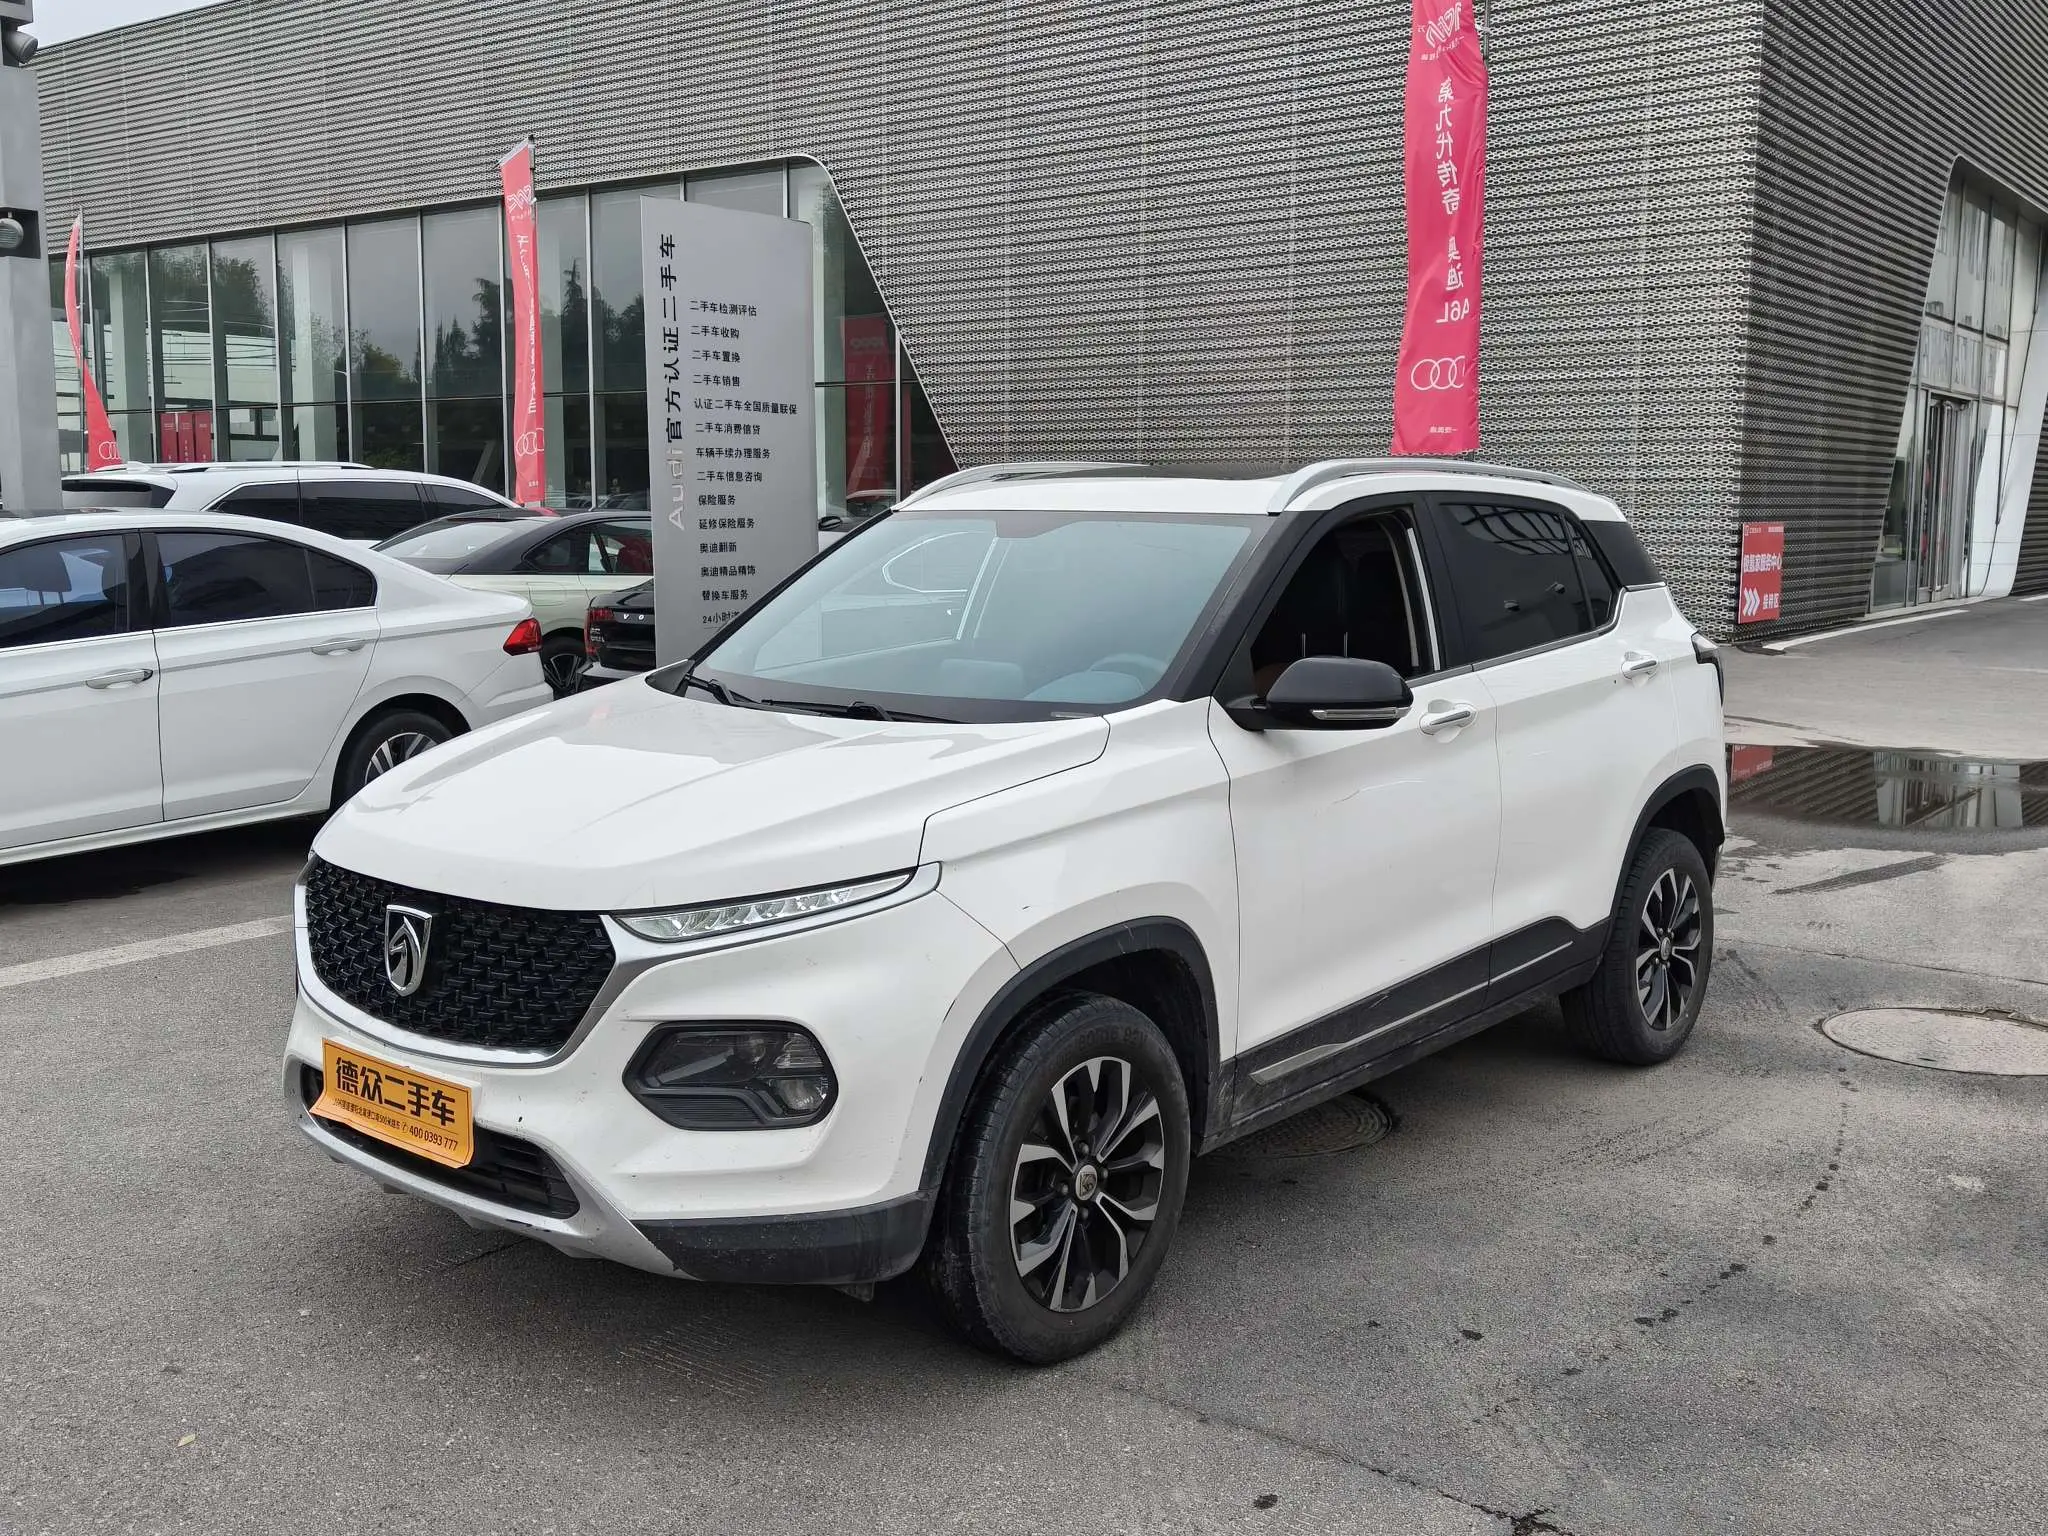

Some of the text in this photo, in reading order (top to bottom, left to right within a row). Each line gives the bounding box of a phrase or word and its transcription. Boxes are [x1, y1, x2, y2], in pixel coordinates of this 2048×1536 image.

[689, 300, 757, 317] 二手车检测评估
[690, 325, 740, 339] 二手车收购
[692, 349, 741, 363] 二手车置换
[660, 233, 686, 530] Audi 官方认证二手车
[692, 374, 740, 387] 二手车销售
[694, 398, 798, 415] 认证二手车全国质量联保
[695, 422, 761, 435] 二手车消费信贷
[695, 447, 771, 459] 车辆手续办理服务
[696, 470, 763, 482] 二手车信息咨询
[698, 494, 736, 506] 保险服务
[699, 517, 755, 530] 延修保险服务
[700, 542, 737, 553] 奥迪翻新
[702, 589, 748, 601] 替换车服务
[336, 1057, 456, 1126] 德众二手车
